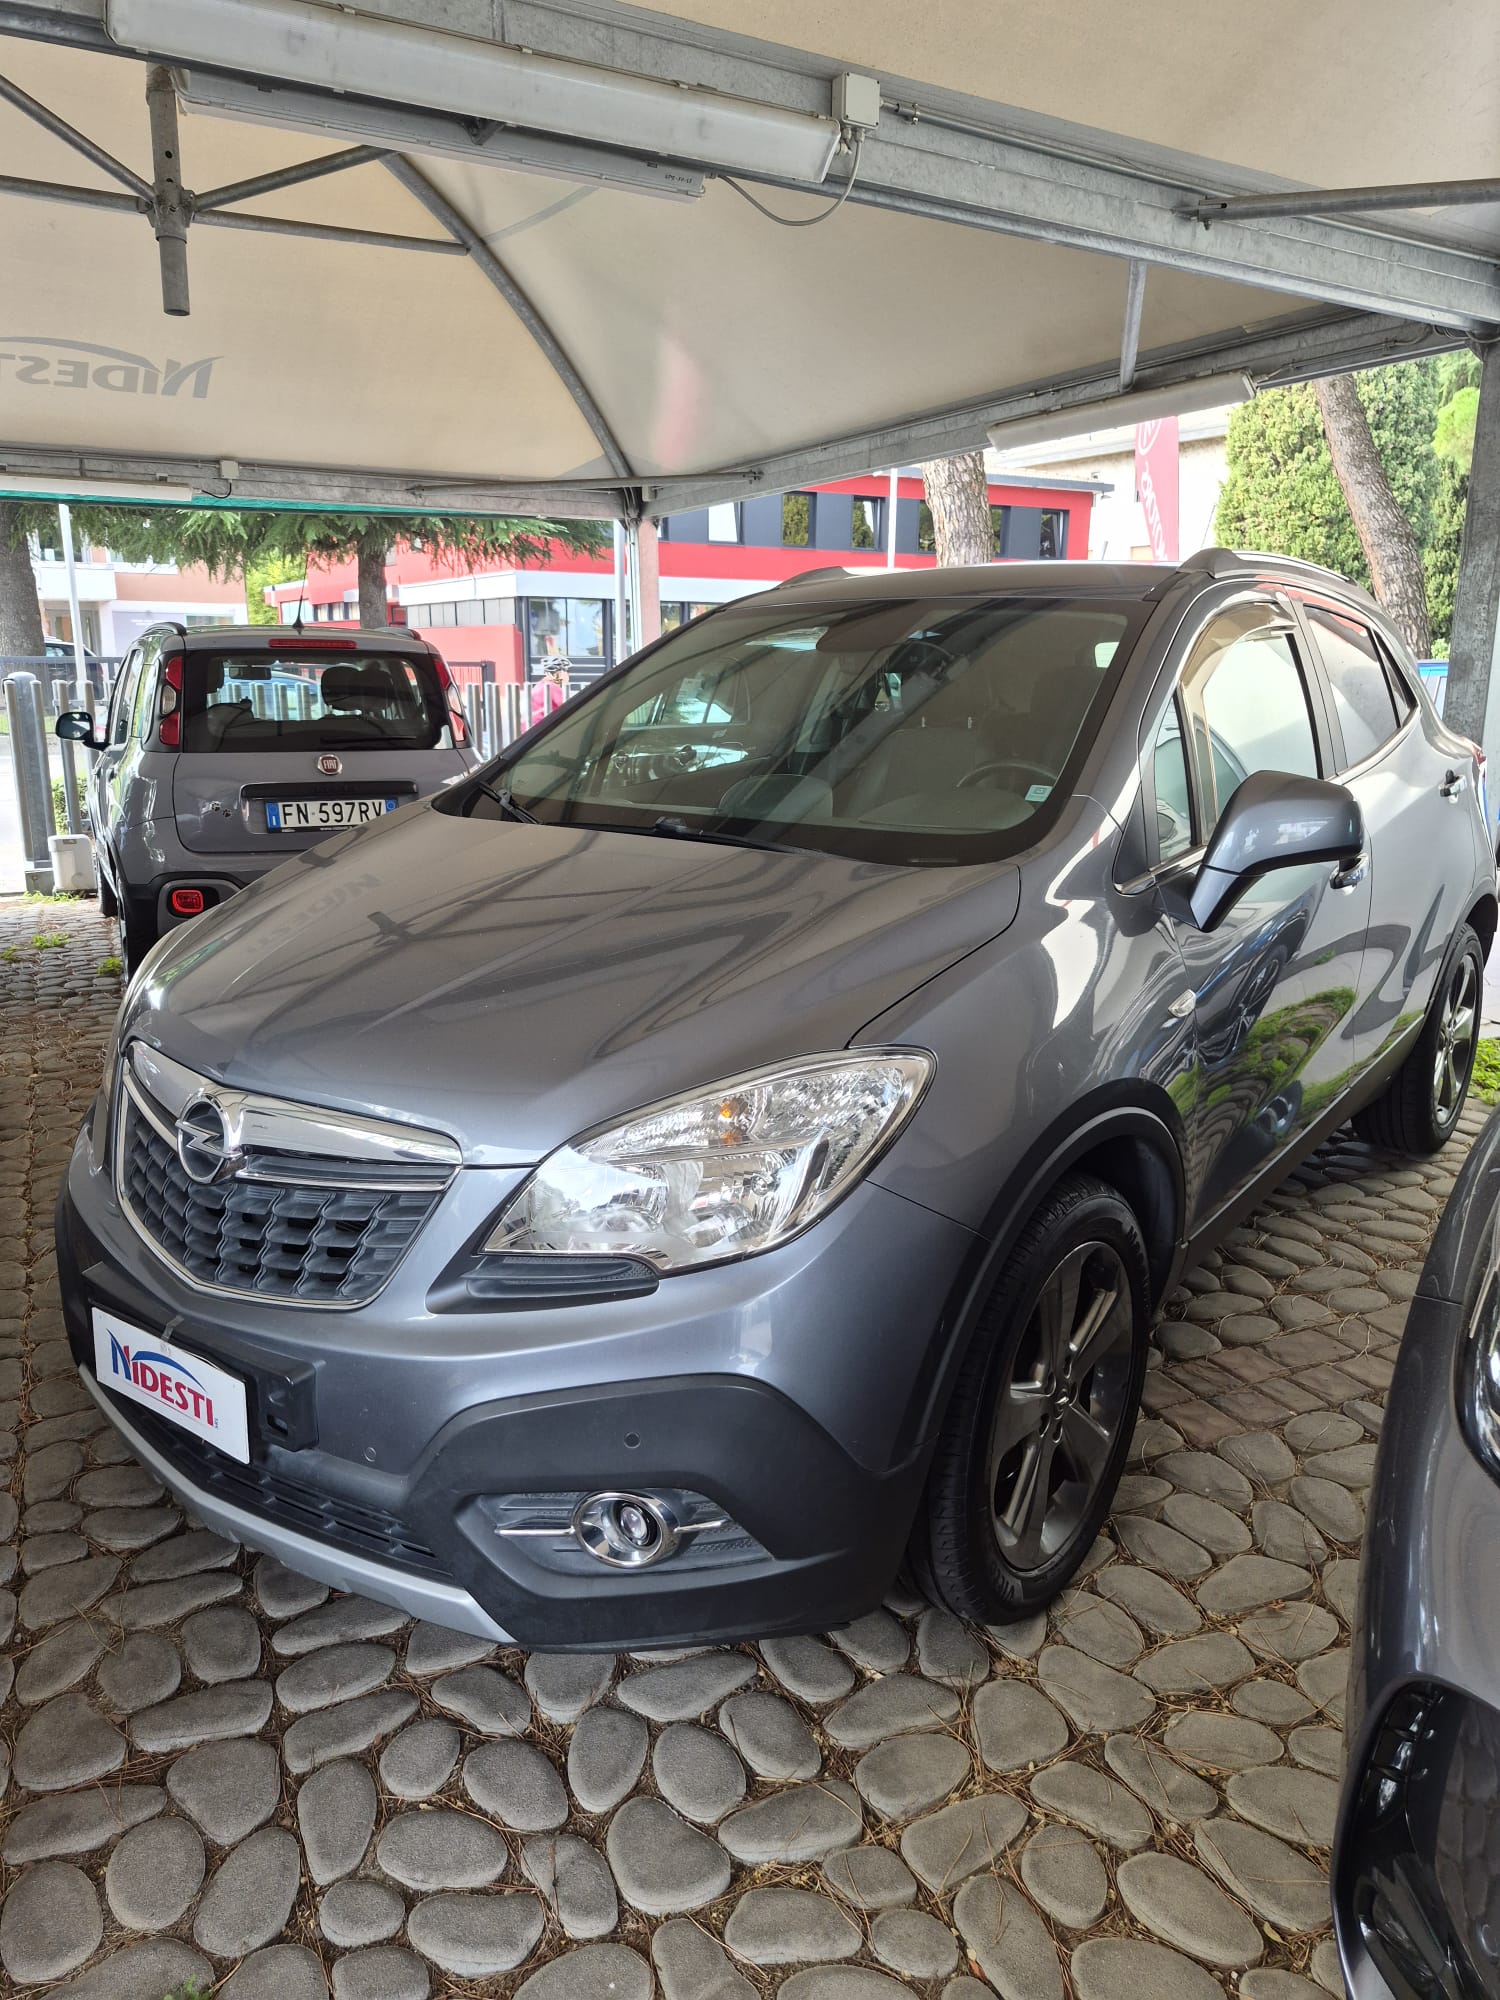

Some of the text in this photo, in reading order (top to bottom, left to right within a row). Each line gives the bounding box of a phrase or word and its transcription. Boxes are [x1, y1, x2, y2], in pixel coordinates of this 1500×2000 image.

[282, 803, 309, 825] FN
[318, 801, 382, 823] 597RV
[106, 1328, 214, 1426] NIDESTI
